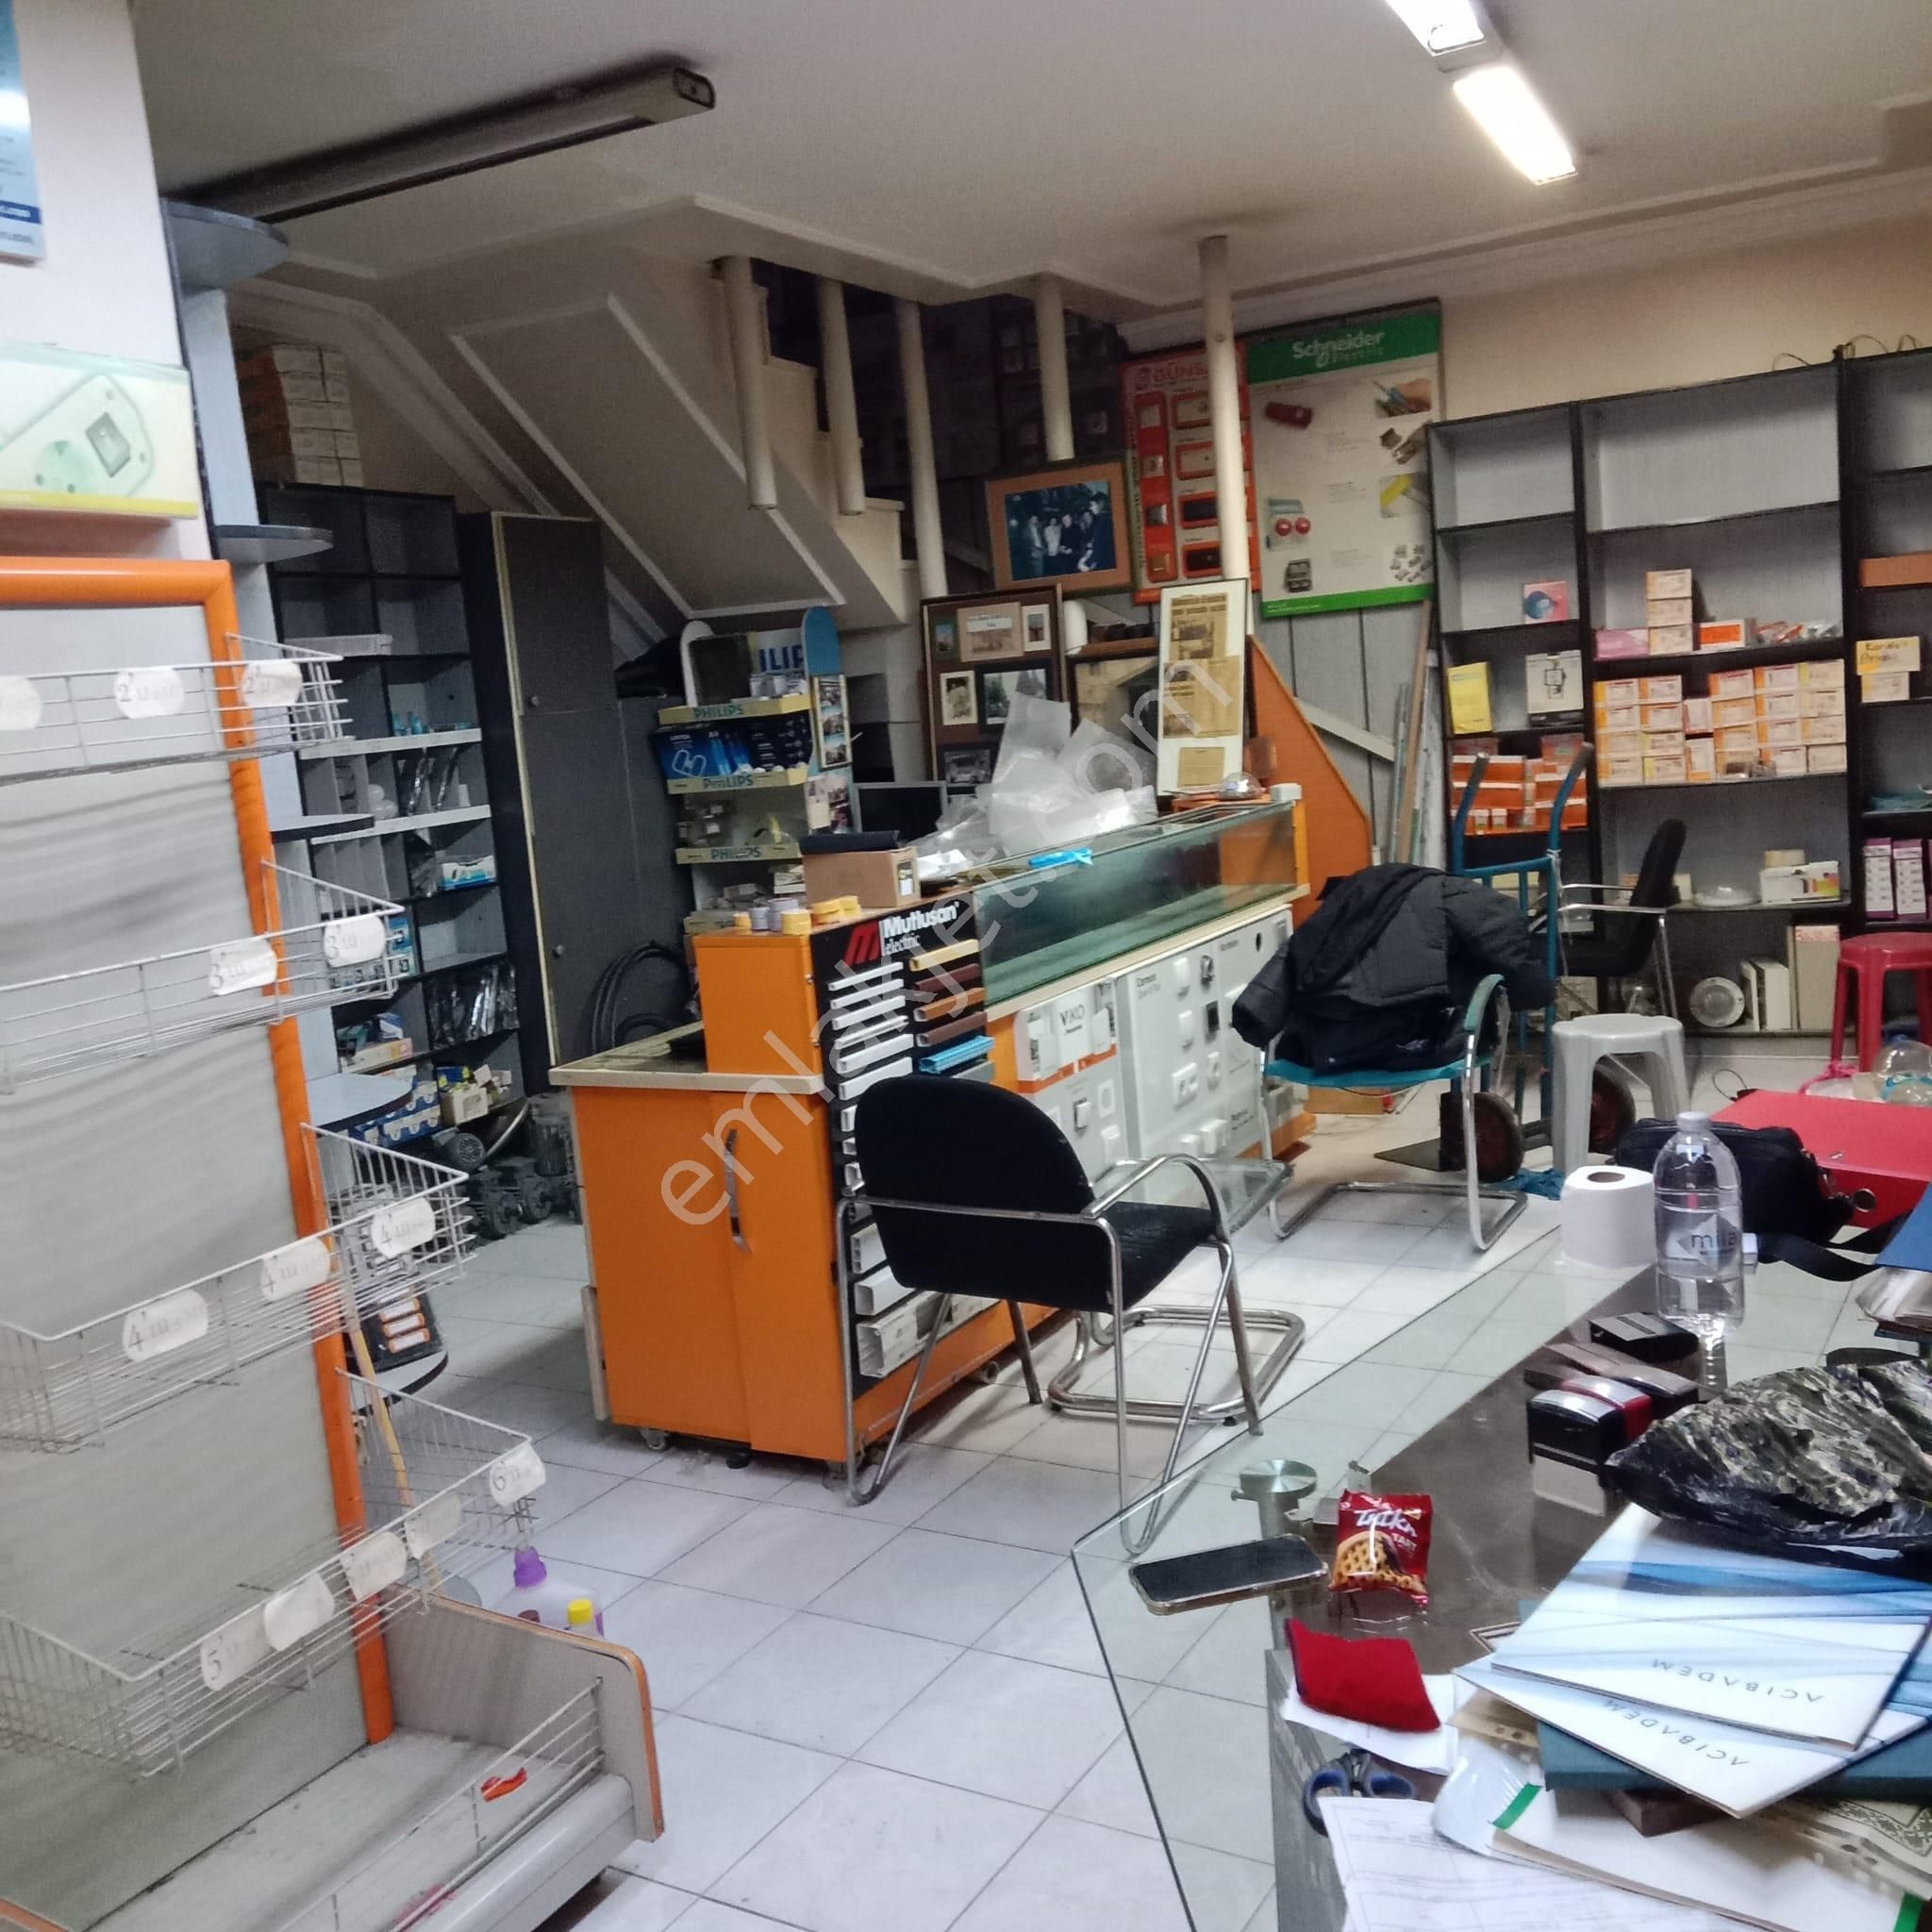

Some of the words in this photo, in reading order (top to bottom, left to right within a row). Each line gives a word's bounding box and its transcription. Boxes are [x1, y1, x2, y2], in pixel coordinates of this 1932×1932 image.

[1292, 332, 1385, 359] Schneider
[1153, 362, 1208, 382] GÜNS
[758, 645, 804, 673] ILIP
[883, 905, 958, 938] Mutlusan
[1653, 1658, 1825, 1703] ACIBADEM
[1604, 1700, 1751, 1766] ACIBADEM
